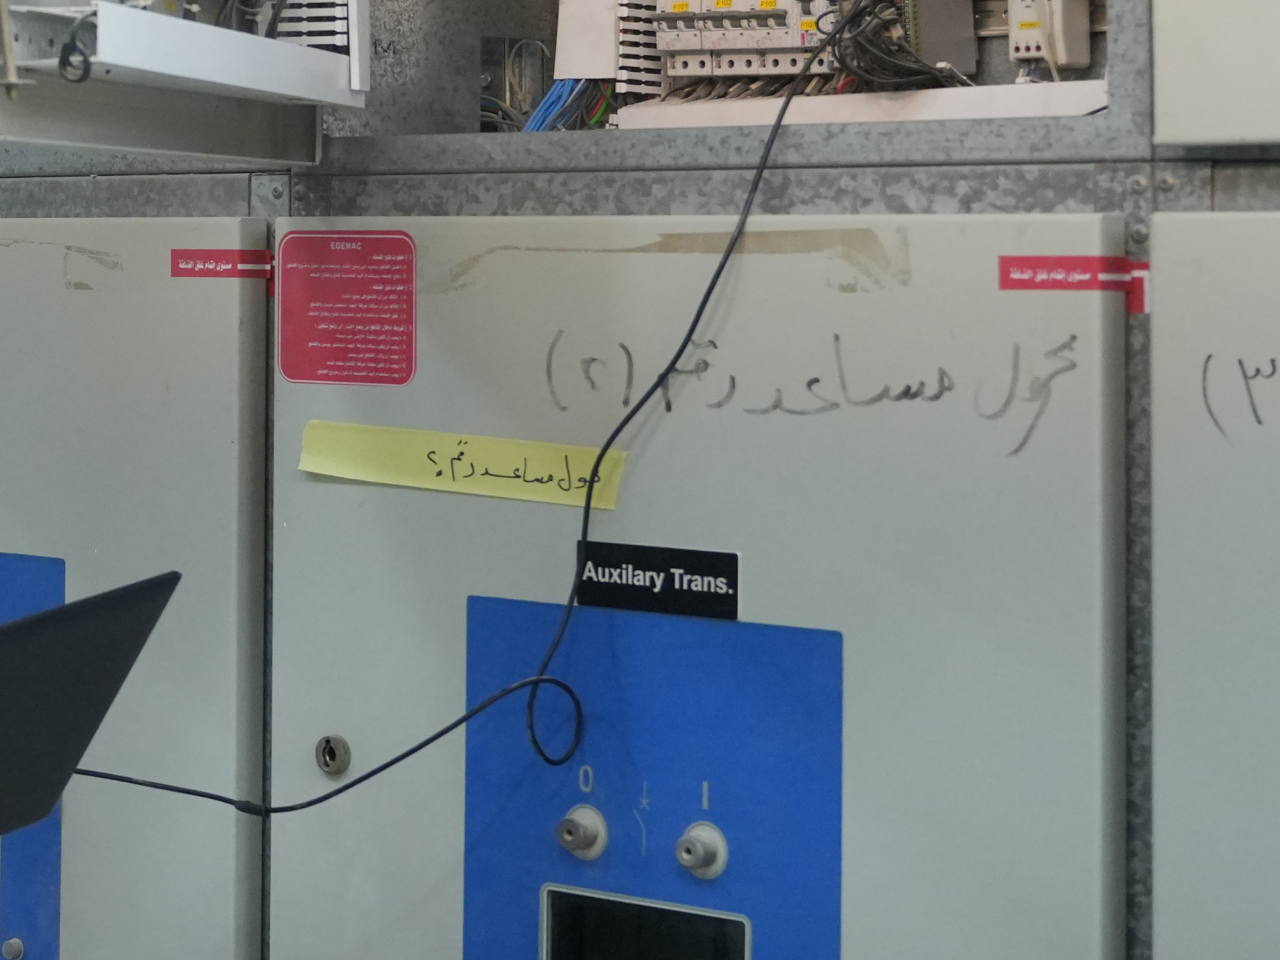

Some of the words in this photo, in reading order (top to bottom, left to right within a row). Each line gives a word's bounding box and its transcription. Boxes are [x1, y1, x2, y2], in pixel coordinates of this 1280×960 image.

[672, 2, 688, 11] F101
[760, 0, 776, 8] F103
[330, 242, 362, 250] EGEMAC
[217, 260, 232, 272] مستوى
[743, 333, 957, 416] مساعد
[450, 439, 476, 482] رقم
[480, 457, 554, 484] مساعد
[582, 560, 665, 593] Auxilary
[670, 568, 734, 594] Trans.
[578, 765, 594, 793] 0
